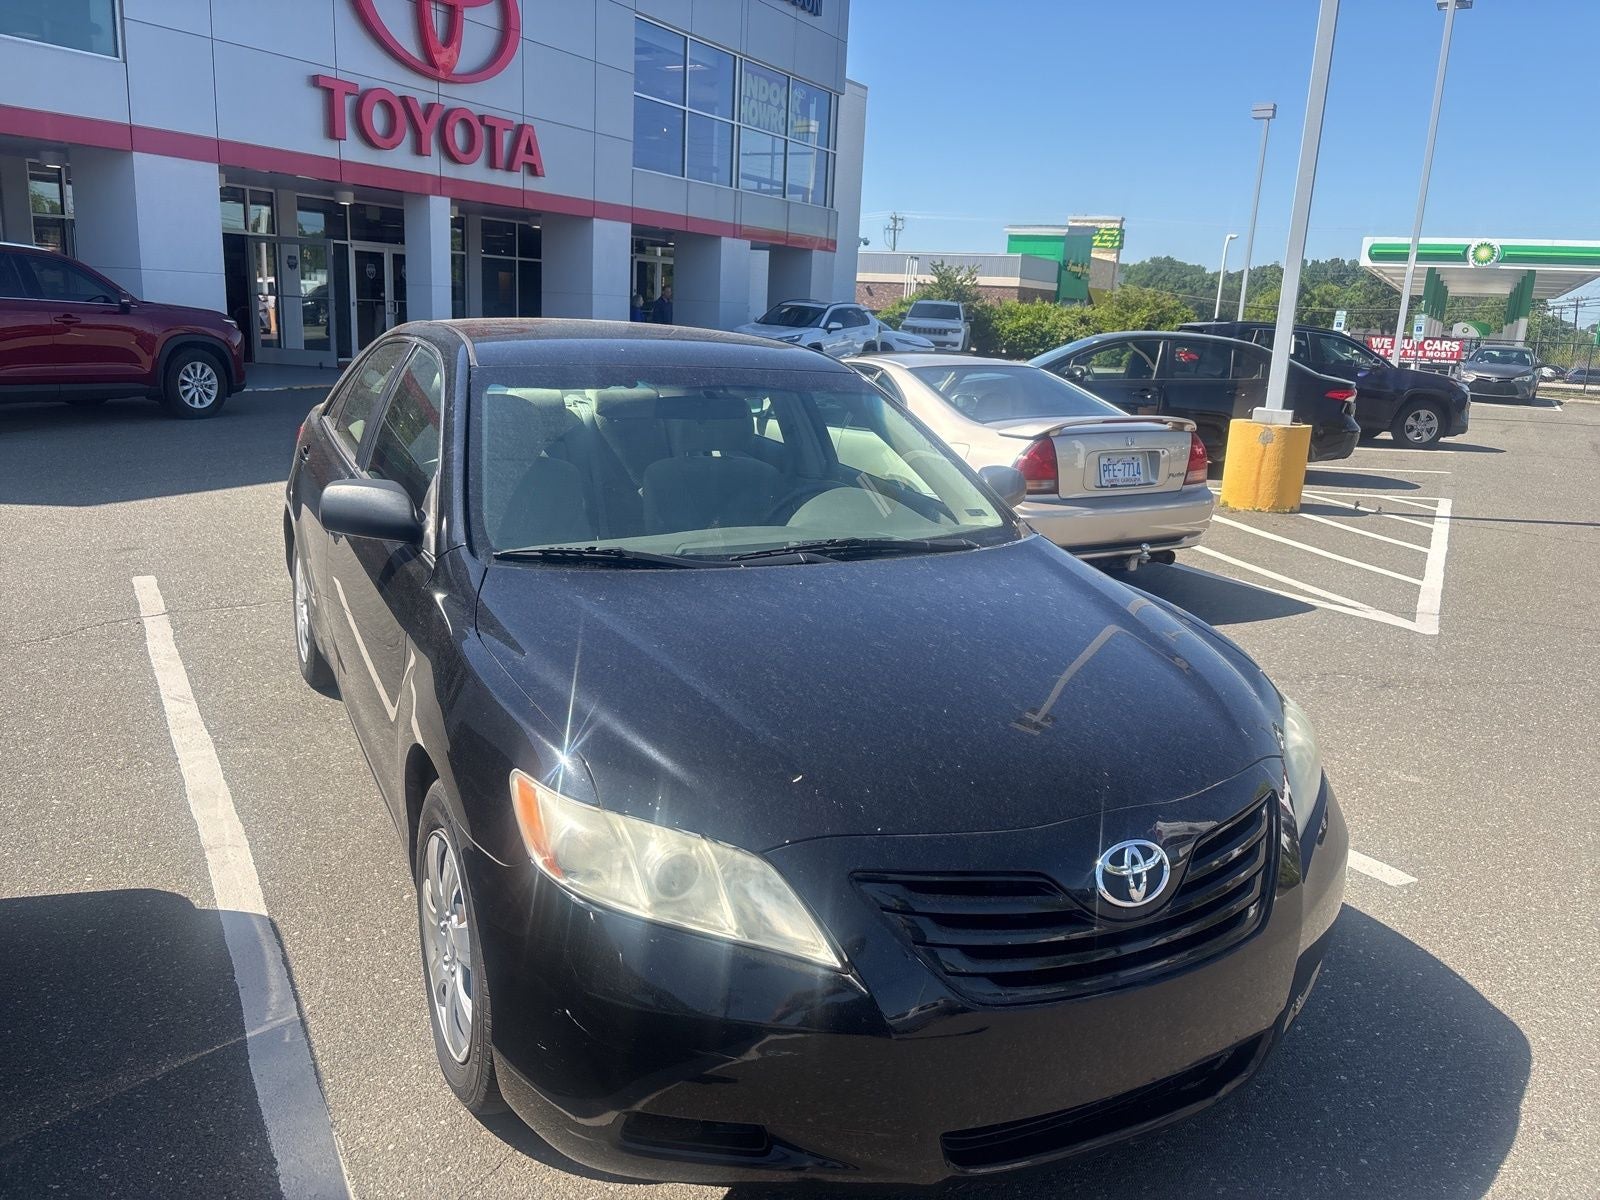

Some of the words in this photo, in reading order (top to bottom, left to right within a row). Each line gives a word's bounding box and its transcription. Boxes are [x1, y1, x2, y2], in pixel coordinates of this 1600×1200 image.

[312, 74, 545, 177] TOYOTA
[1372, 338, 1392, 348] WE
[1424, 340, 1460, 351] CARS
[1103, 462, 1141, 478] PFE-7714
